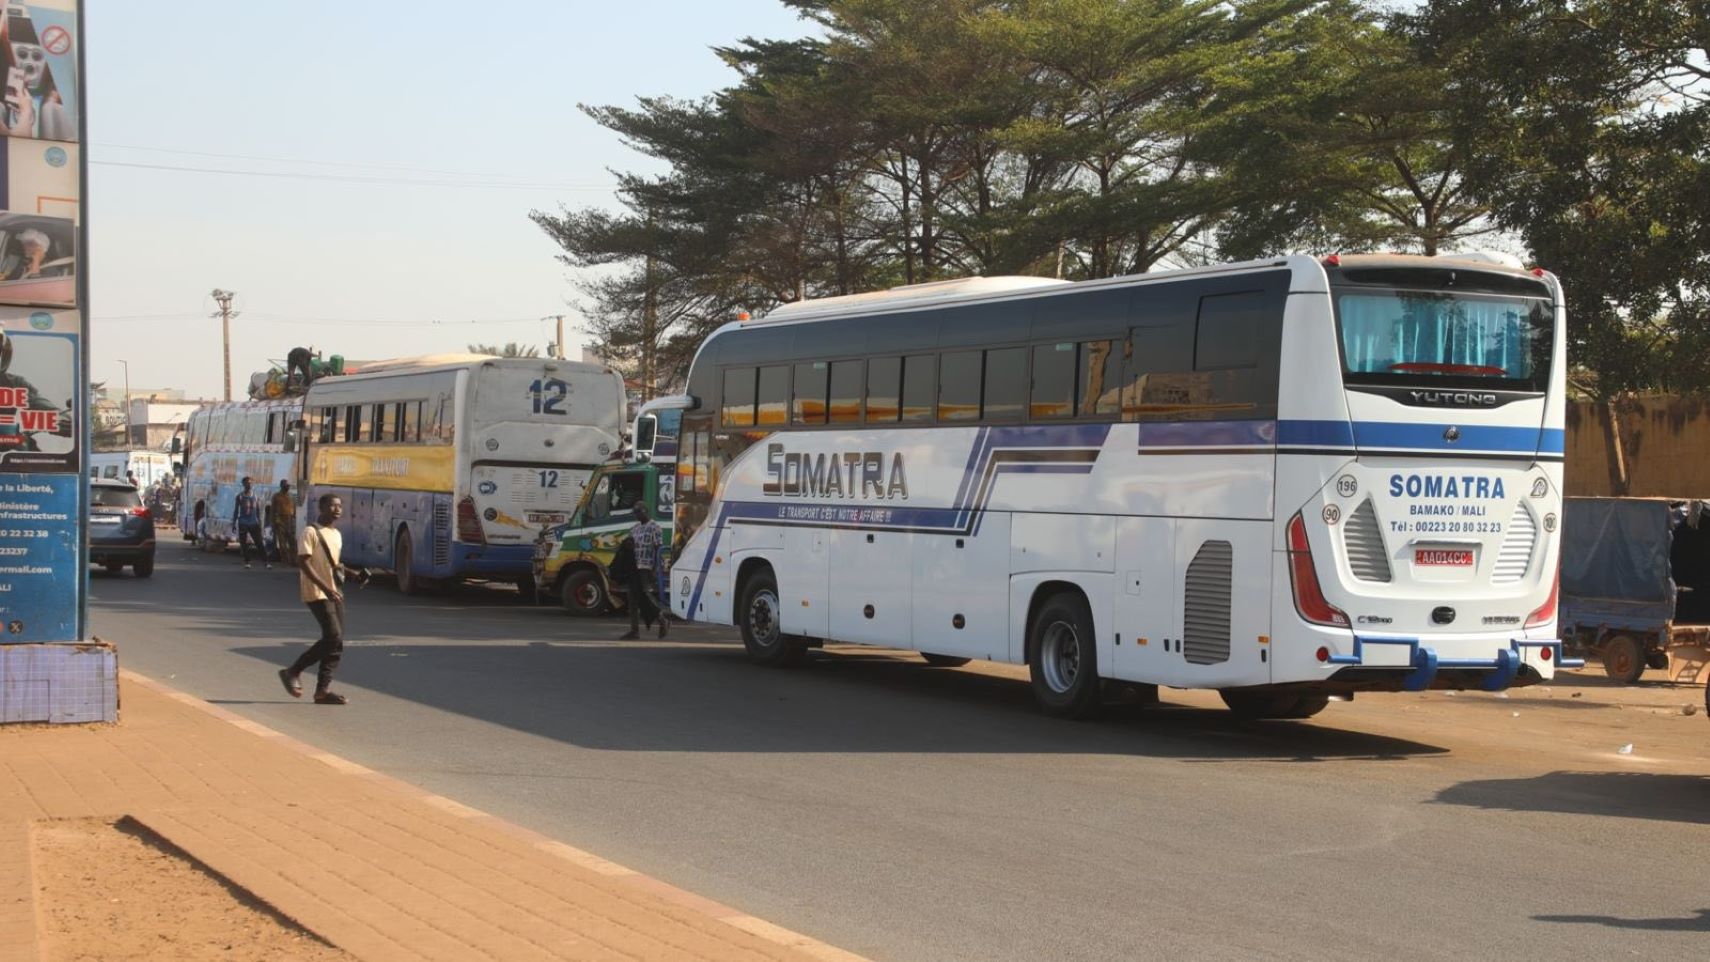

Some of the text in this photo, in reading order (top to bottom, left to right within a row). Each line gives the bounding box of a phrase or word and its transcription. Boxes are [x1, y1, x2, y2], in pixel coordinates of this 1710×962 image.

[529, 379, 567, 415] 12
[1410, 391, 1497, 405] YUTONG
[19, 411, 58, 430] VIE
[763, 443, 909, 500] SOMATRA
[538, 470, 559, 488] 12
[1338, 480, 1357, 492] 196
[5, 484, 14, 492] la
[1389, 474, 1505, 499] SOMATRA
[778, 506, 786, 517] LE
[787, 507, 821, 520] TRANSPORT
[838, 508, 860, 521] NOTRE
[859, 510, 884, 523] AFFAIRE
[1325, 508, 1338, 521] 90
[1410, 505, 1454, 515] BAMAKO
[1462, 505, 1486, 516] MALI
[10, 530, 21, 538] 22
[1390, 521, 1407, 532] Tél
[1415, 521, 1446, 533] 00223
[1449, 522, 1461, 533] 20
[1462, 522, 1474, 533] 80
[1477, 522, 1488, 533] 32
[1490, 522, 1501, 533] 23
